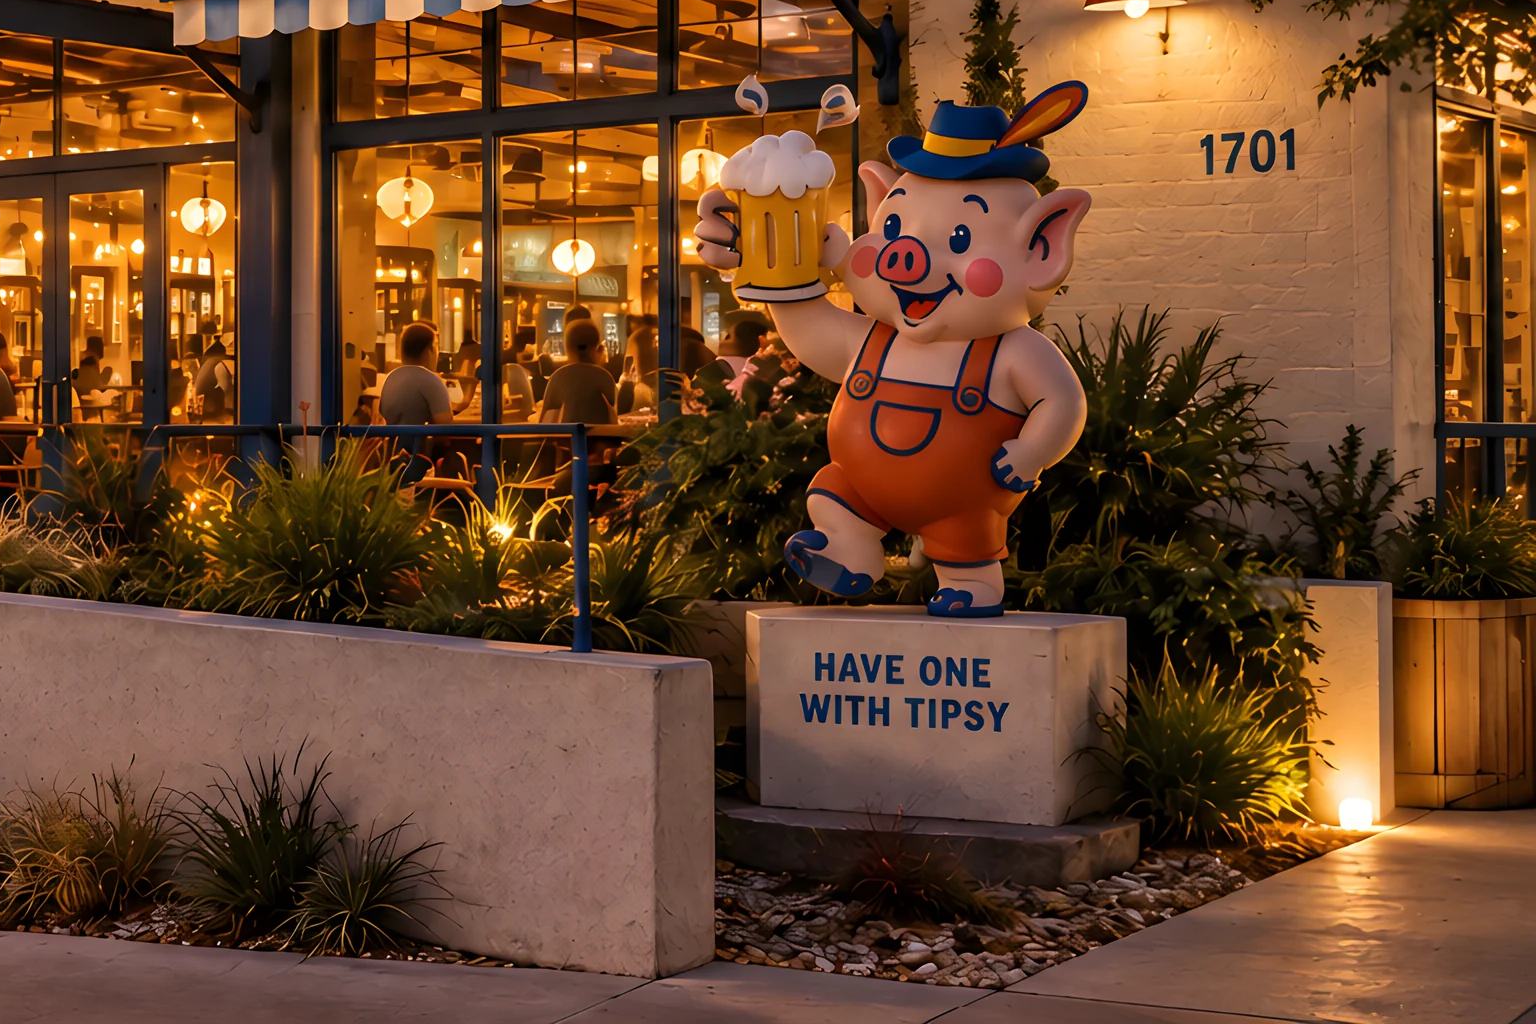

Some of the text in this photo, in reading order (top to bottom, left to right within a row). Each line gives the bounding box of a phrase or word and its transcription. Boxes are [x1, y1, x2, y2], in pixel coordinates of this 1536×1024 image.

[1200, 128, 1295, 175] 1701
[814, 652, 991, 688] HAVE ONE
[799, 693, 1009, 732] WITH TIPSY
